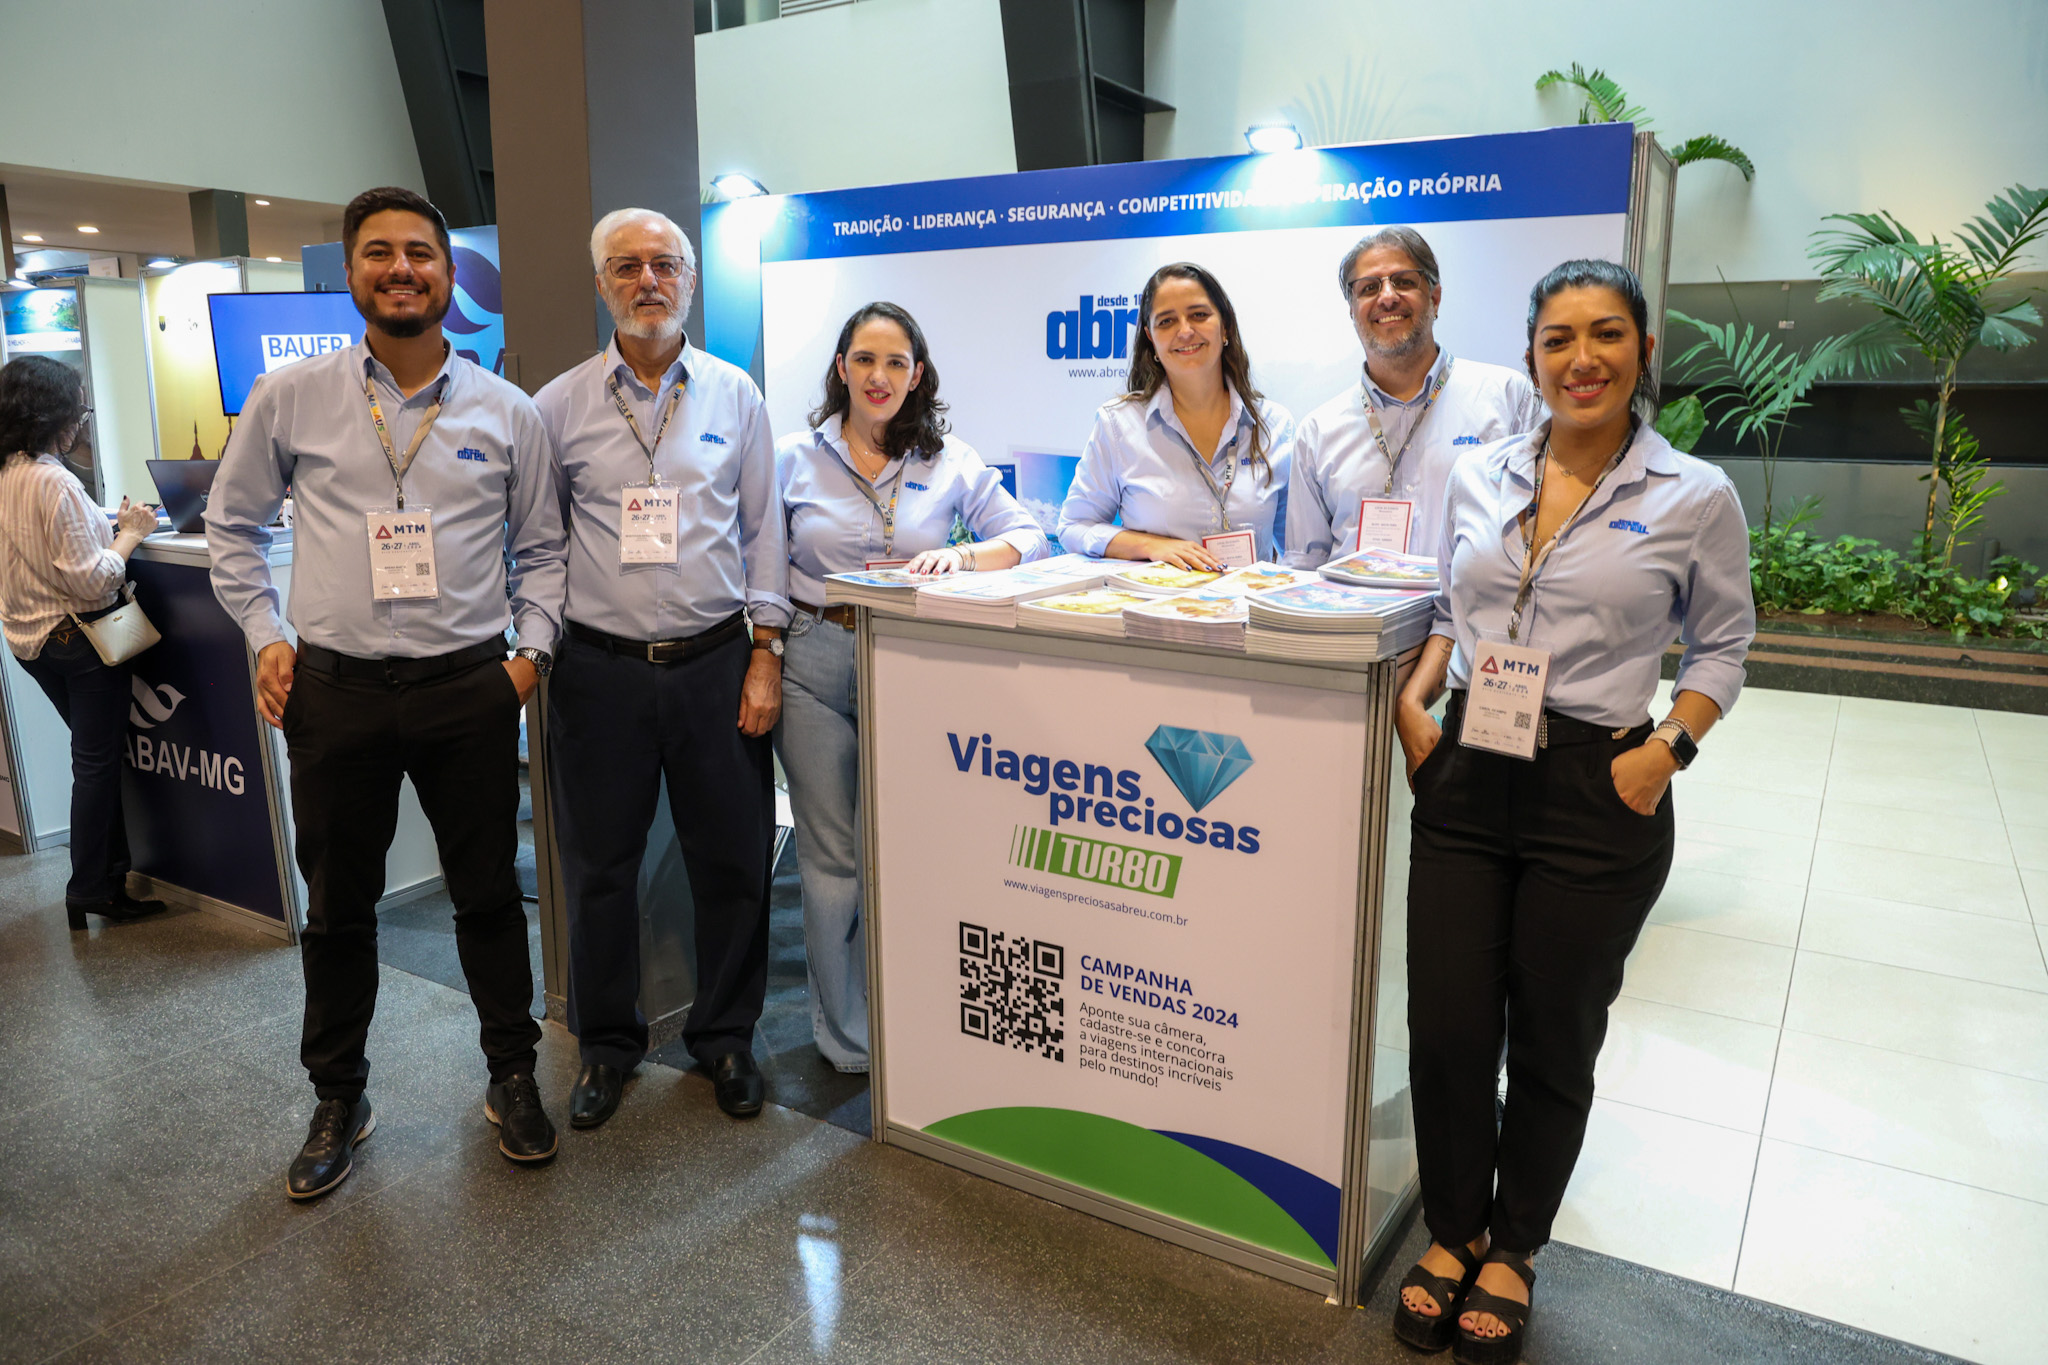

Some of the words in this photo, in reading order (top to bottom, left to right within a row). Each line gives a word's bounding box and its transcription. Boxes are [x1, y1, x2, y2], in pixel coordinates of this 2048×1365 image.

[833, 213, 903, 237] TRADIÇÃO
[913, 209, 997, 231] LIDERANÇA
[1007, 200, 1106, 222] SEGURANÇA
[1118, 188, 1279, 215] COMPETITIVIDA
[1292, 177, 1402, 204] PERAÇÃO
[1408, 173, 1502, 196] PRÓPRIA
[1097, 295, 1128, 307] desde
[1046, 295, 1139, 360] abr
[381, 542, 391, 550] 26
[393, 542, 403, 550] 27
[394, 524, 426, 534] MTM
[1483, 677, 1494, 687] 26
[1497, 680, 1508, 690] 27
[1503, 659, 1539, 676] MTM
[947, 732, 1142, 802] Viagens
[1050, 791, 1260, 854] preciosas
[1061, 836, 1171, 893] TURBO
[1003, 878, 1188, 927] www.viagenspreciosasabreu.com.br
[1080, 955, 1193, 996] CAMPANHA
[1080, 1002, 1125, 1023] Aponte
[1128, 1015, 1150, 1030] sua
[1154, 1022, 1207, 1046] câmera,
[1081, 975, 1104, 995] DE
[1109, 982, 1186, 1015] VENDAS
[1192, 1003, 1239, 1028] 2024
[1080, 1016, 1151, 1044] cadastre-se
[1155, 1037, 1163, 1047] e
[1166, 1041, 1225, 1064] concorra
[1080, 1031, 1087, 1040] a
[1090, 1032, 1137, 1054] viagens
[1140, 1045, 1234, 1081] internacionais
[1080, 1044, 1107, 1060] para
[1111, 1051, 1164, 1076] destinos
[1168, 1065, 1222, 1092] incríveis
[1080, 1056, 1106, 1073] pelo
[1109, 1064, 1158, 1088] mundo!
